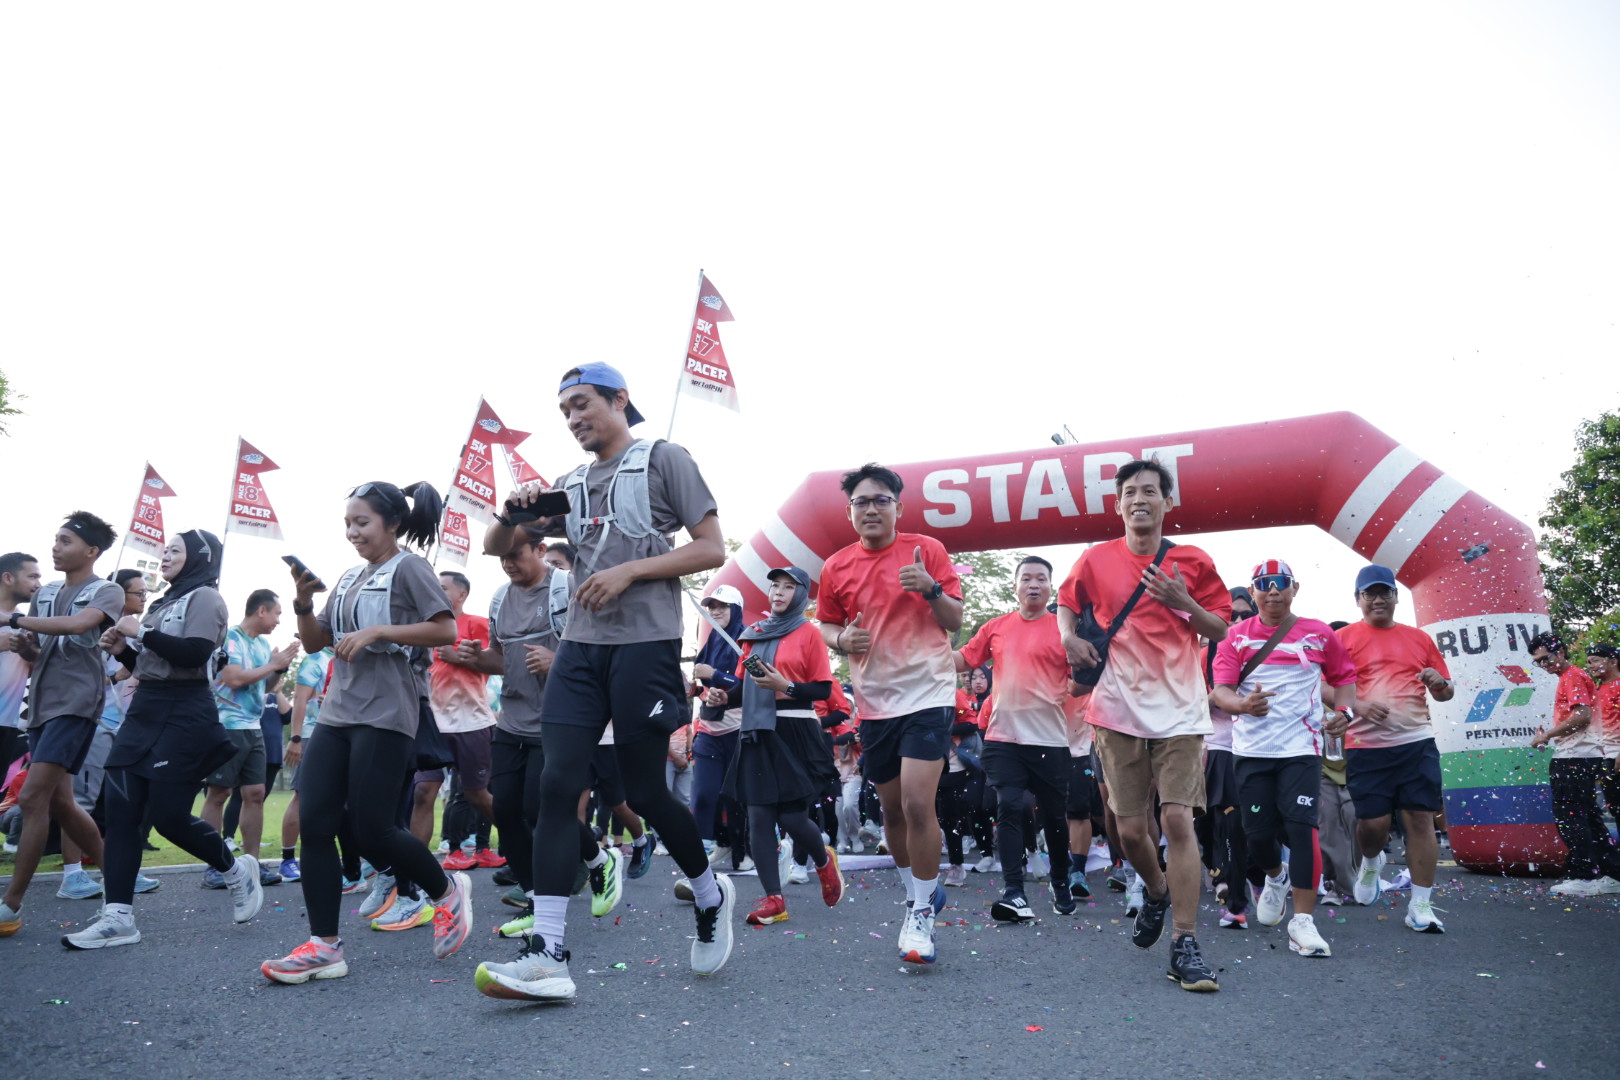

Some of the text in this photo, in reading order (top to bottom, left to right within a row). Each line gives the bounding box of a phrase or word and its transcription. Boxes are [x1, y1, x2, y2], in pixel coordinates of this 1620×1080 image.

[696, 318, 713, 335] 5K
[687, 357, 727, 381] PACER
[470, 439, 488, 455] 5K
[238, 472, 254, 485] 5K
[458, 474, 493, 500] PACER
[922, 443, 1194, 528] START
[141, 494, 156, 506] 5K
[234, 503, 272, 519] PACER
[133, 521, 162, 539] PACER
[443, 531, 469, 548] PACER
[1436, 623, 1539, 658] RU IV
[1466, 727, 1541, 740] PERTAMIN
